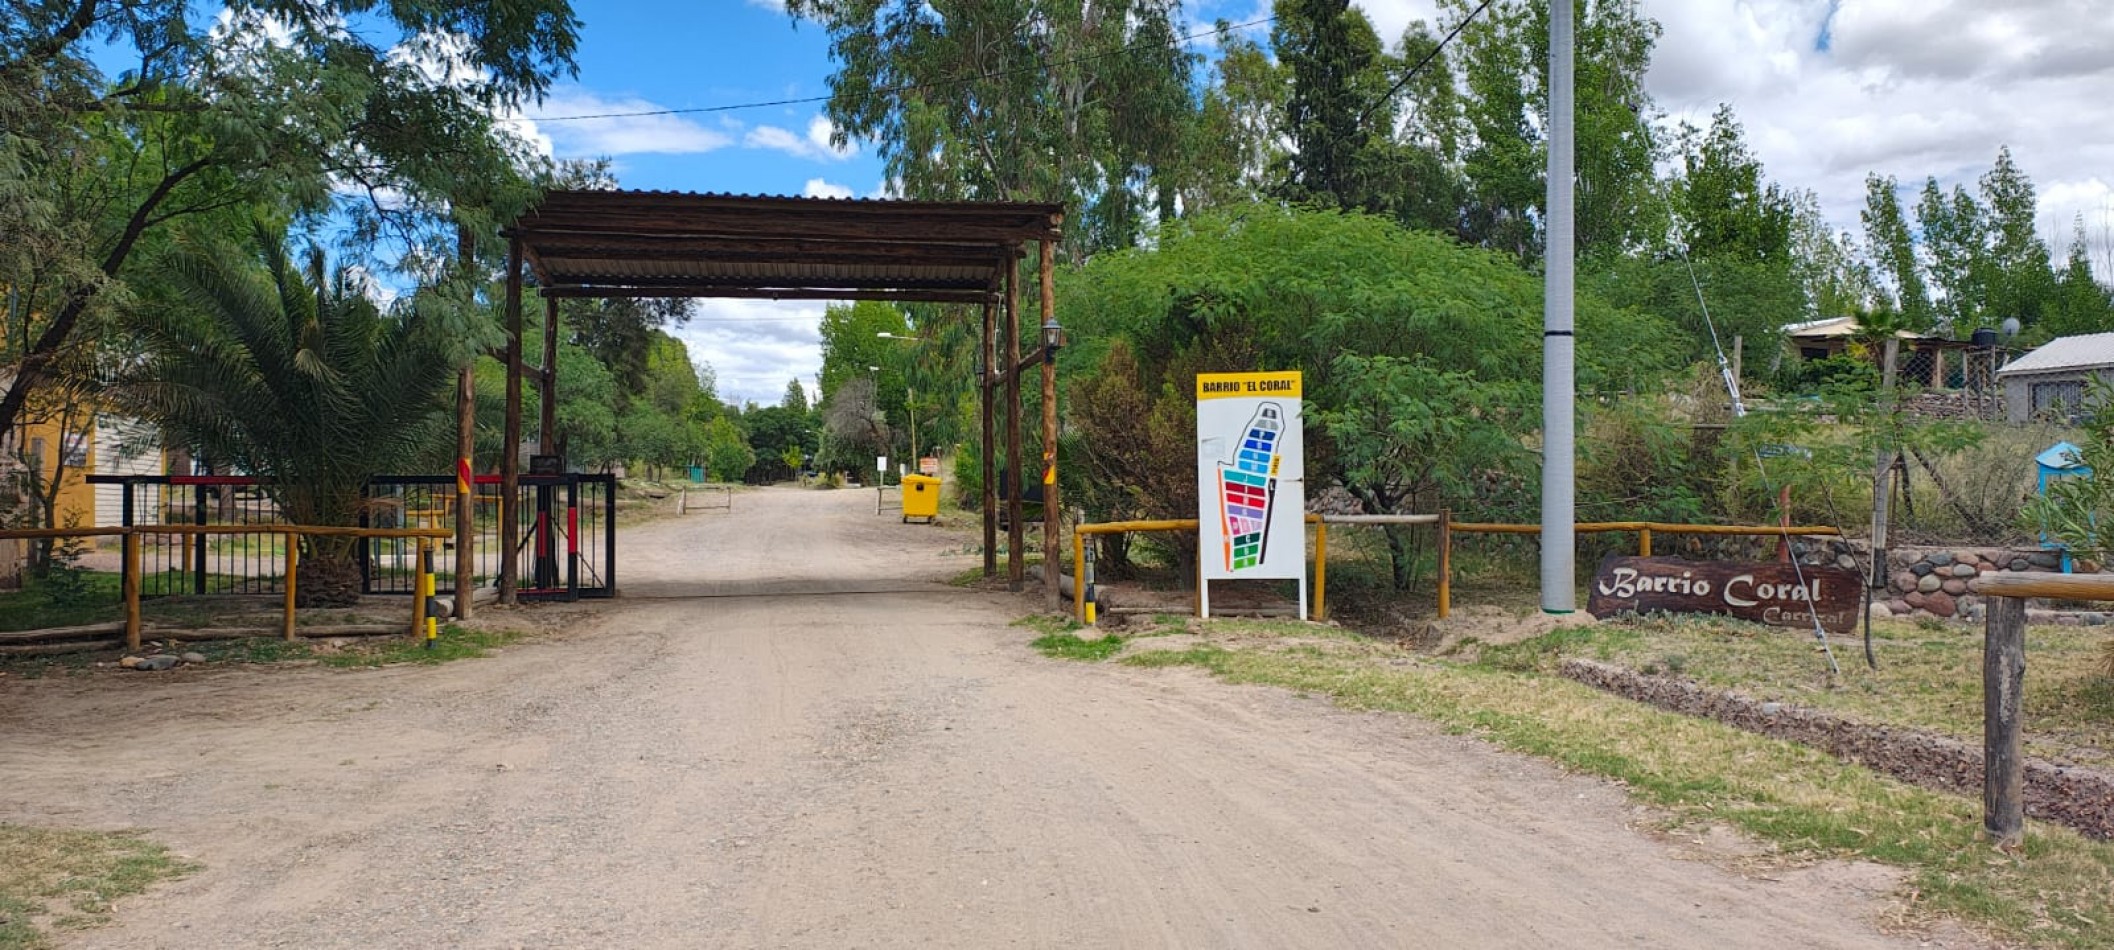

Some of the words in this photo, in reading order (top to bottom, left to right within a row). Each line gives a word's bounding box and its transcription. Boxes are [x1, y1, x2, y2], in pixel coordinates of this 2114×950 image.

[1203, 382, 1240, 392] BARRIO
[1599, 567, 1710, 598] Barrio
[1723, 574, 1822, 607] Coral
